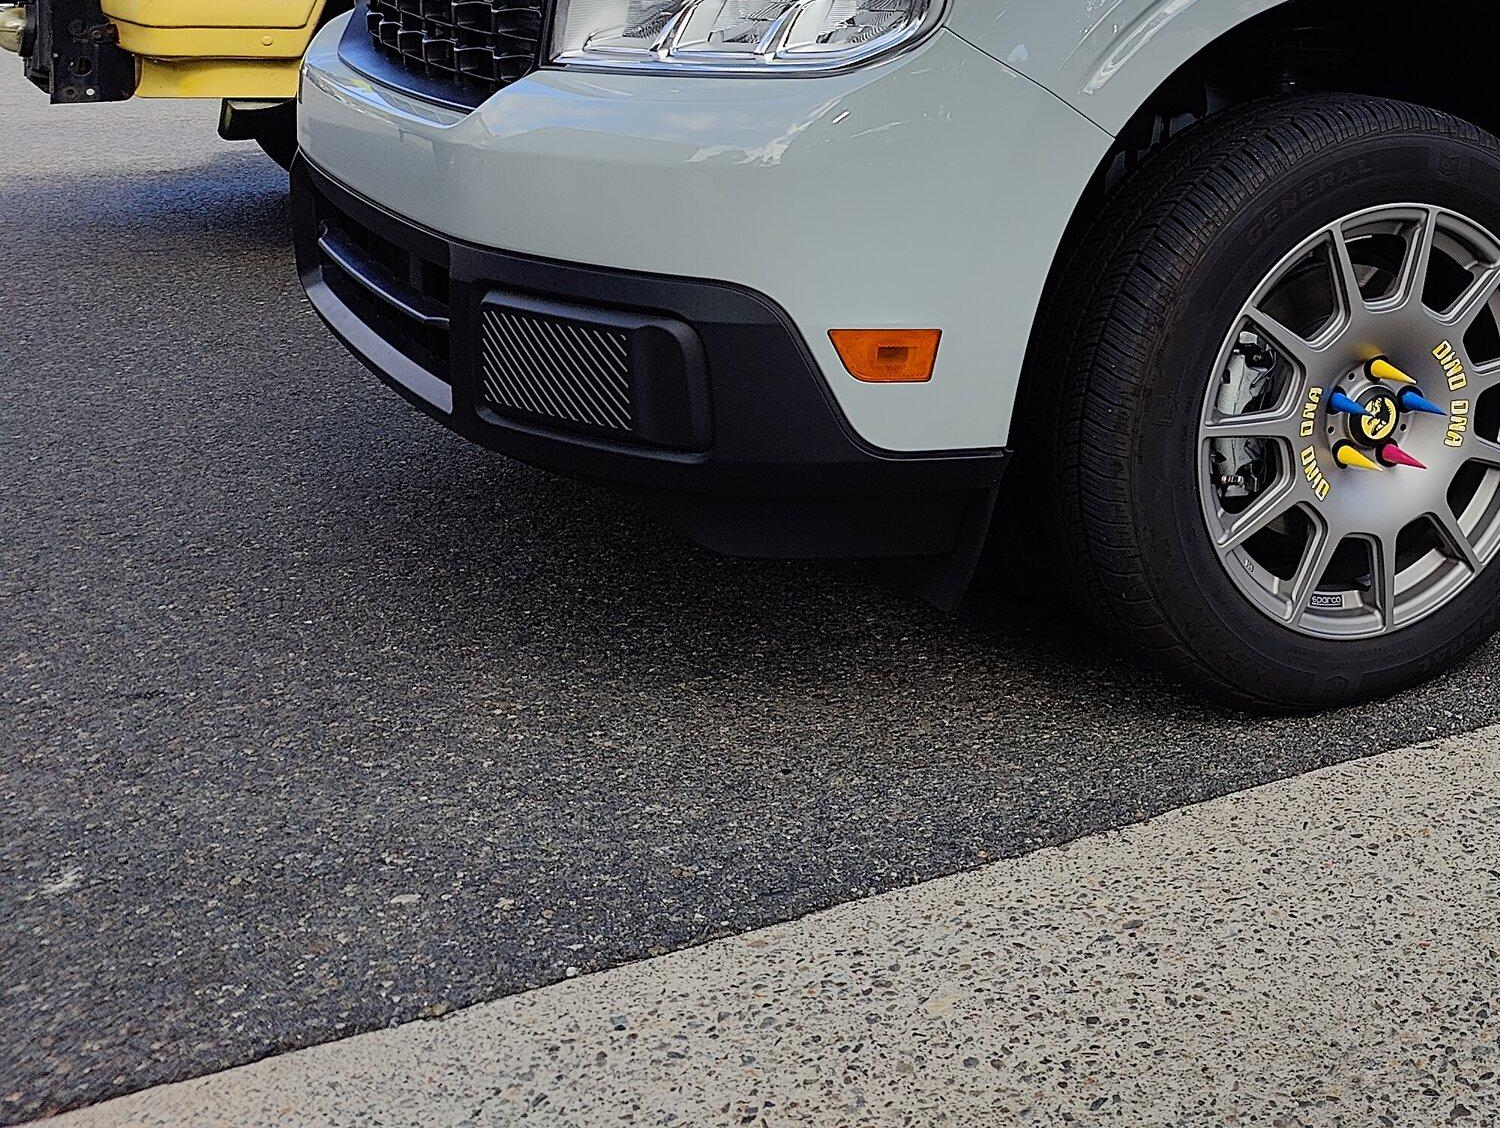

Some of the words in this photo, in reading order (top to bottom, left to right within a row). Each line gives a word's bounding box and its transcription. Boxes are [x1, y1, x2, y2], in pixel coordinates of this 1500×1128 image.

[1431, 339, 1468, 392] DINO
[1299, 386, 1323, 437] DNA
[1443, 398, 1470, 448] DNA
[1300, 444, 1331, 502] DINO
[1311, 594, 1342, 605] sparco
